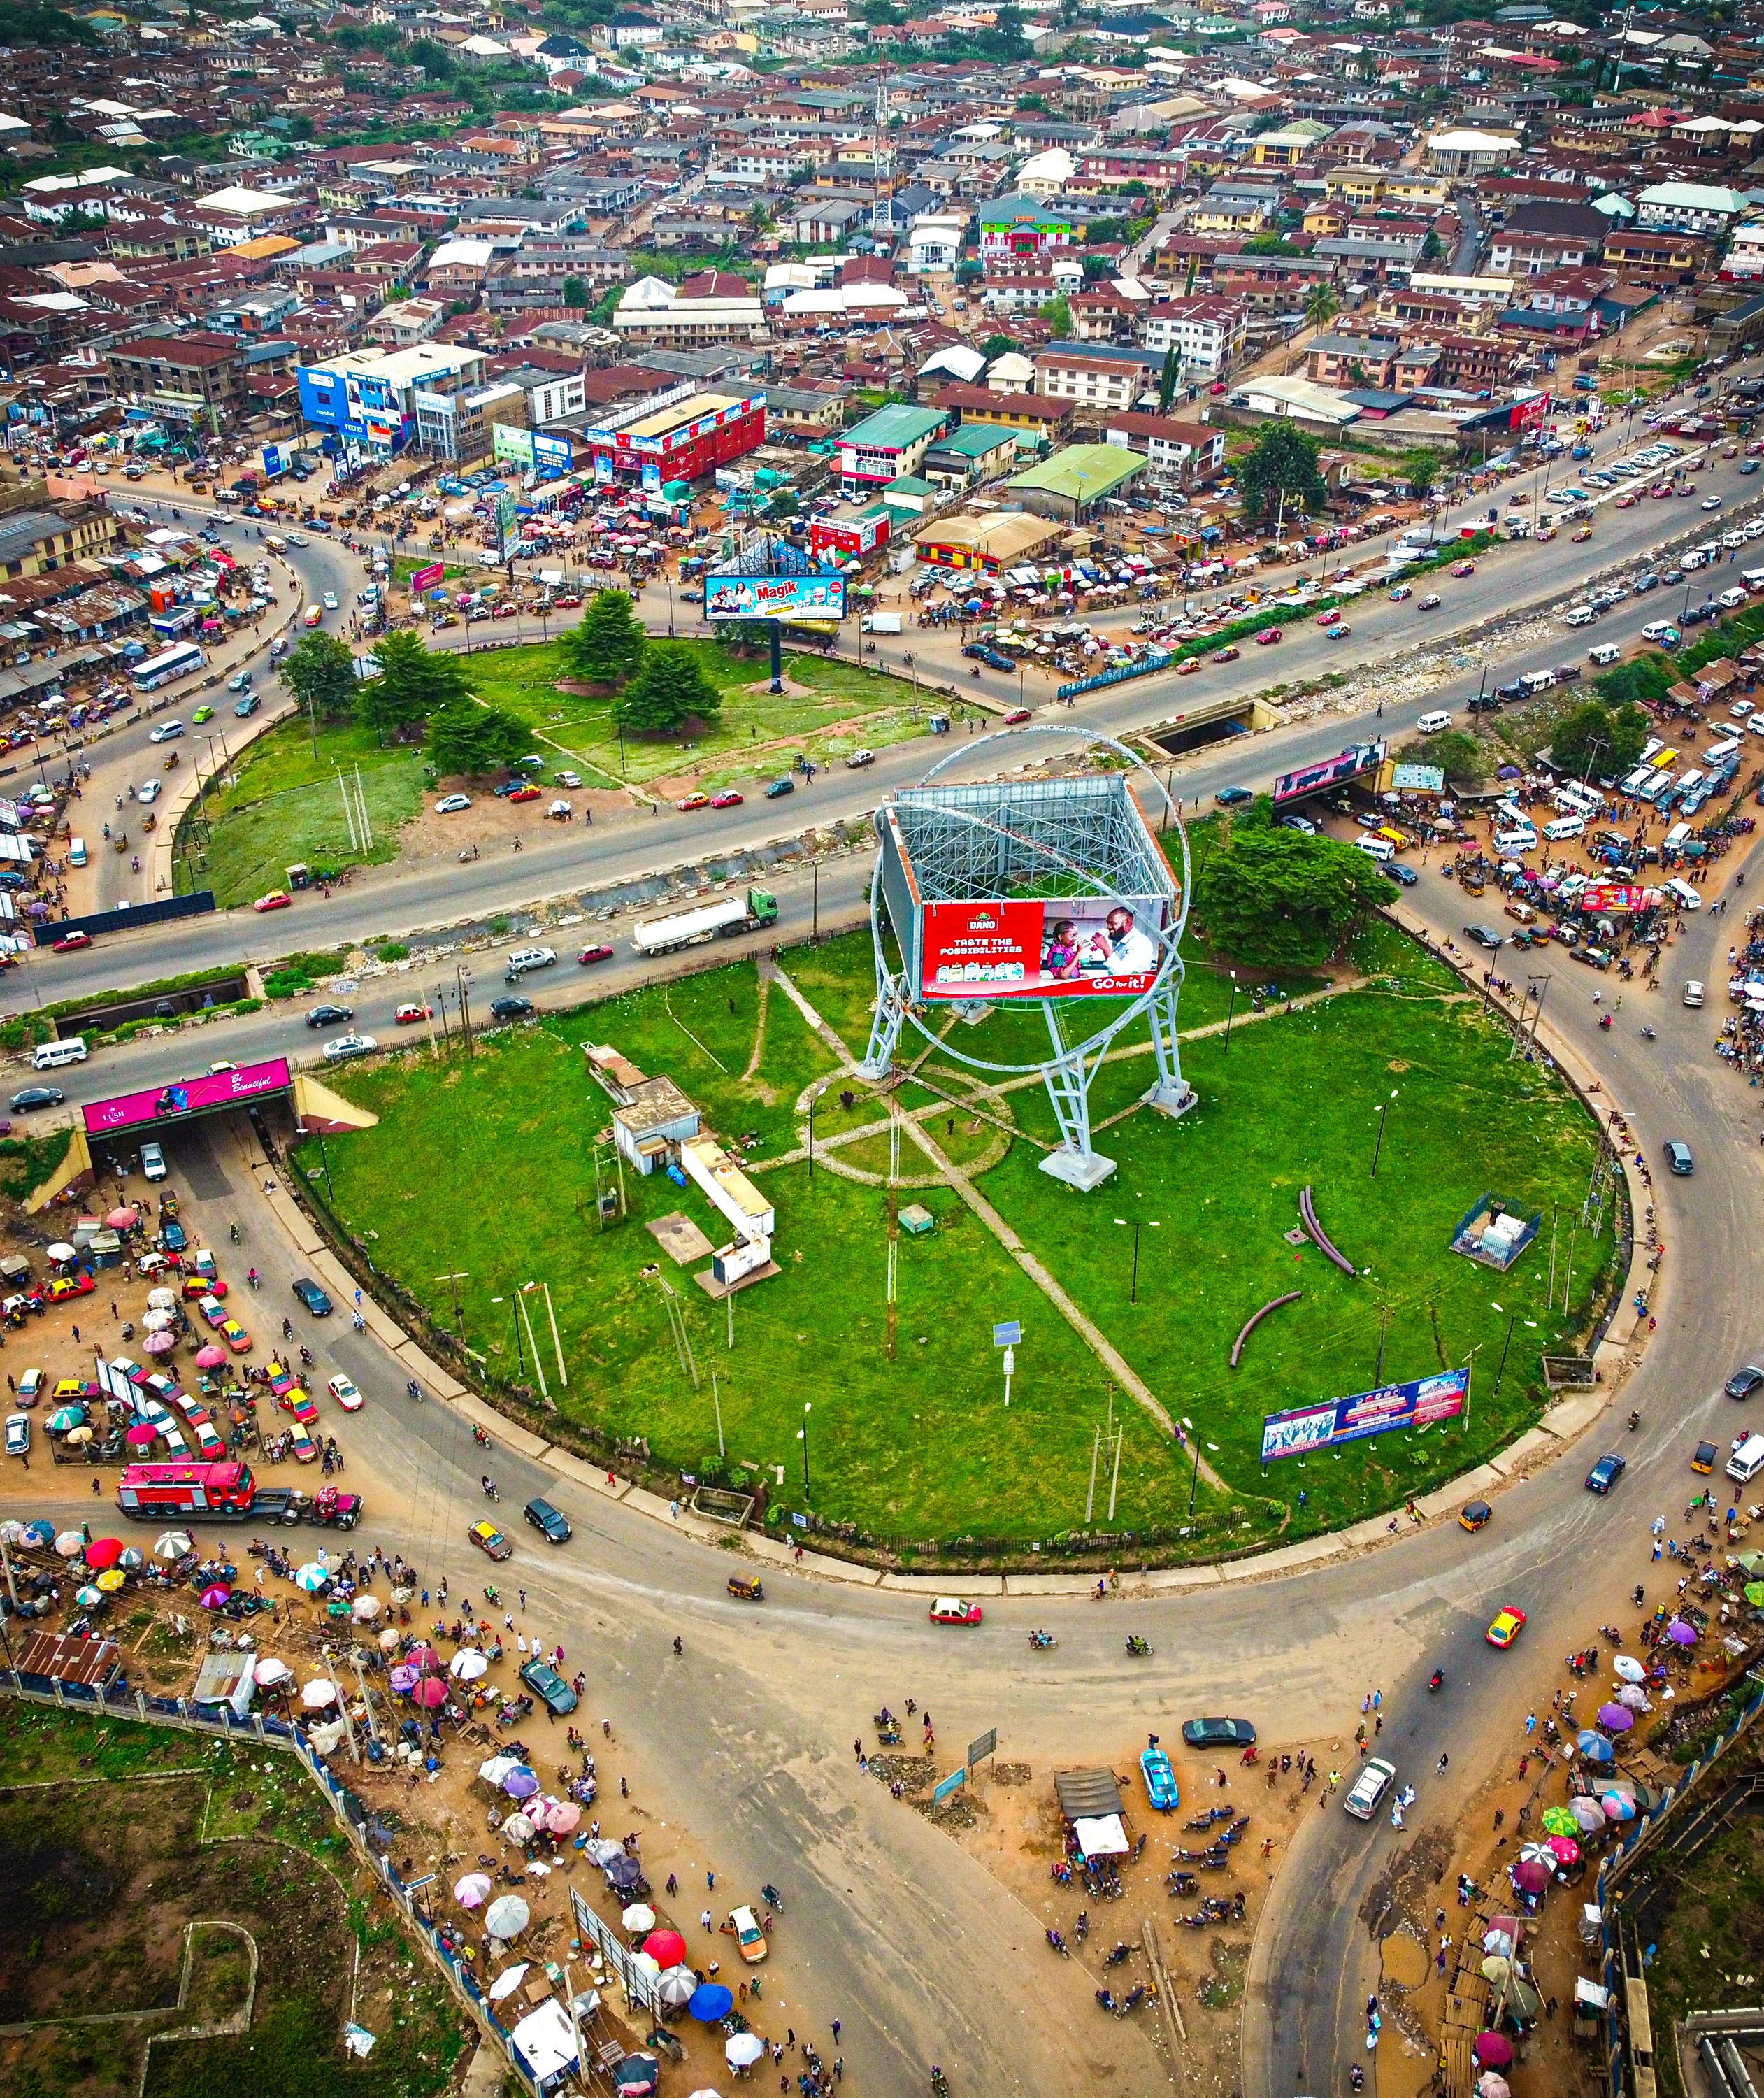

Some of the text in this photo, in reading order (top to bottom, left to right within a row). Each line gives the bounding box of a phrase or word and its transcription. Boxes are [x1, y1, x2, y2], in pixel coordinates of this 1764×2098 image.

[431, 370, 447, 378] STATION
[367, 376, 387, 385] STATION
[344, 424, 363, 433] TECNO
[756, 581, 798, 601] Magik
[970, 920, 996, 929] DANO
[940, 946, 1023, 956] POSSIBILITIES
[1092, 978, 1114, 990] GO
[1128, 976, 1145, 989] it!
[231, 1073, 243, 1083] Be
[232, 1076, 271, 1092] Beautiful
